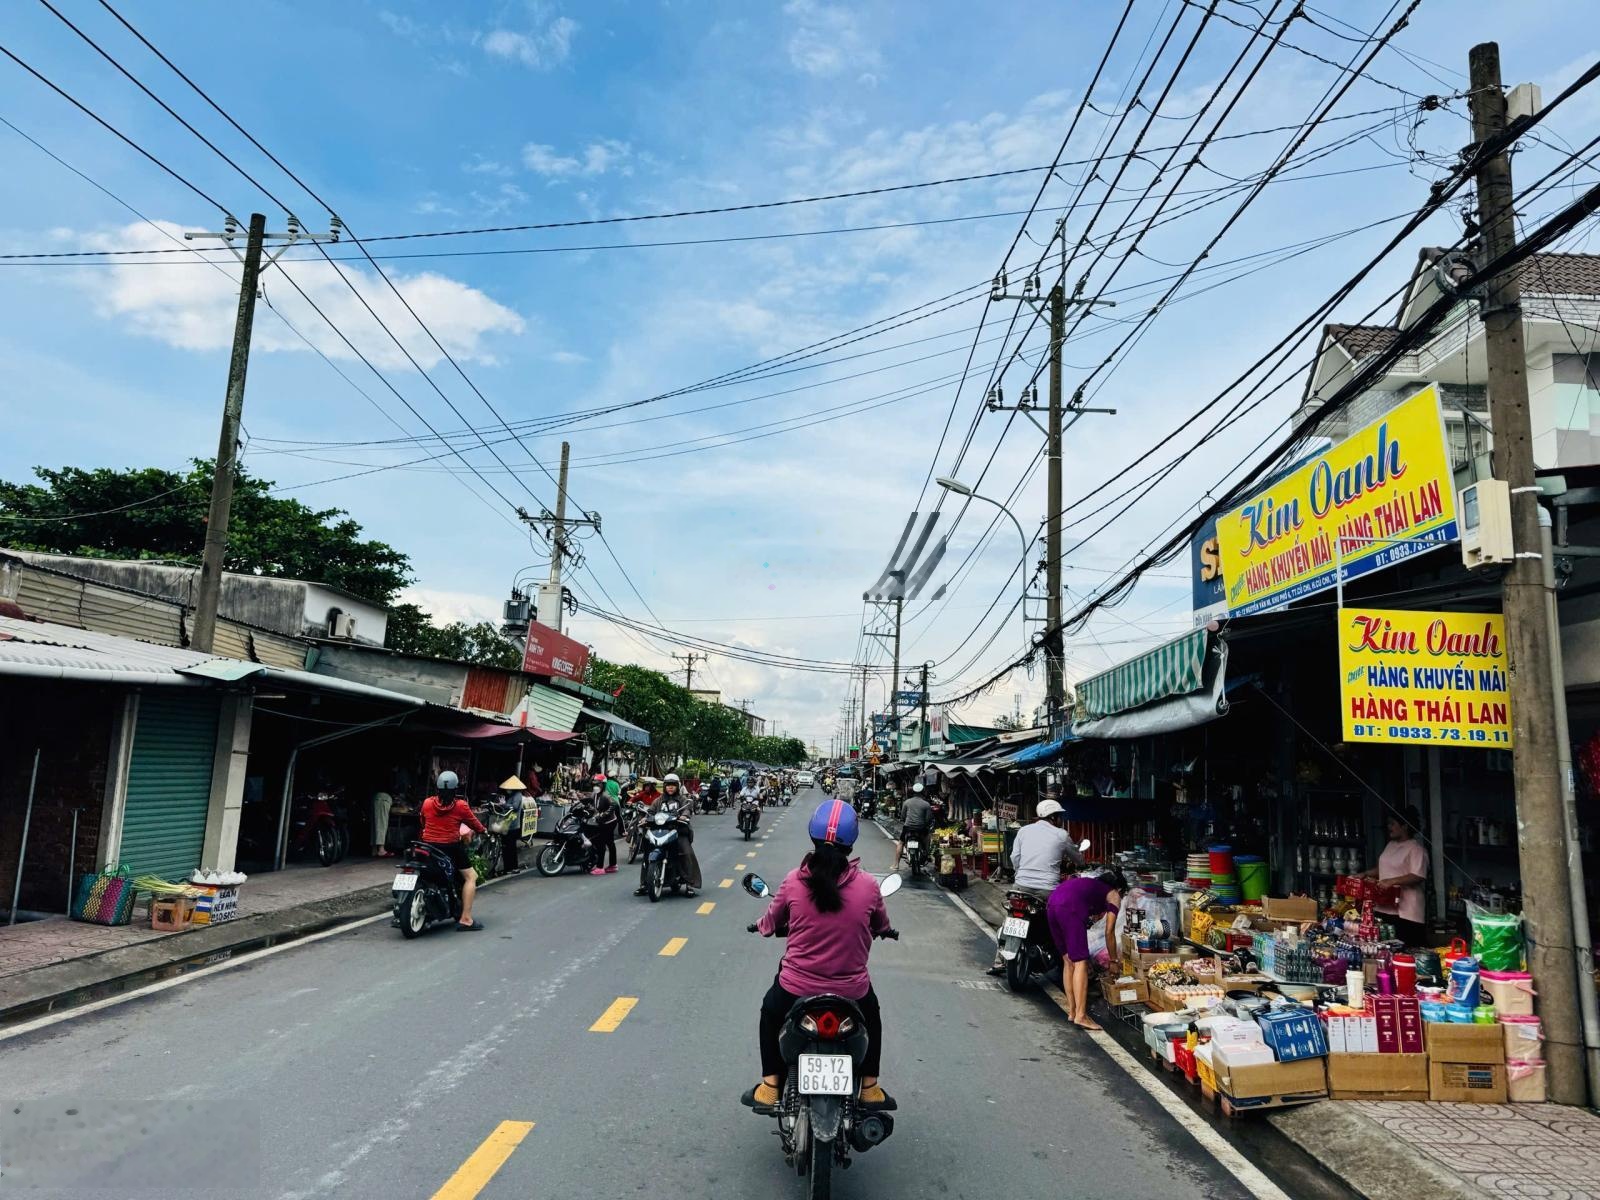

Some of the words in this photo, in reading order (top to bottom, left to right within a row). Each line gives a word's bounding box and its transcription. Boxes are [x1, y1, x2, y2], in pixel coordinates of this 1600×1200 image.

[1239, 496, 1304, 556] Kim
[1310, 422, 1407, 519] Oanh
[1245, 561, 1271, 595] HÀNG
[1271, 534, 1311, 586] KHUYẾN
[1338, 513, 1374, 556] HÀNG
[1374, 491, 1409, 539] THÁI
[1410, 480, 1442, 525] LAN
[1200, 537, 1224, 582] S
[1349, 615, 1419, 653] Kim
[1426, 619, 1503, 657] Oanh
[1368, 660, 1409, 689] HÀNG
[1414, 660, 1475, 691] KHUYẾN
[1479, 665, 1507, 692] MÃI
[1351, 692, 1408, 721] HÀNG
[1413, 696, 1461, 723] THÁI
[1468, 702, 1508, 725] LAN
[1354, 724, 1382, 737] ĐT:
[1388, 726, 1509, 743] 0933.73.19.11
[802, 1074, 849, 1092] 864.87
